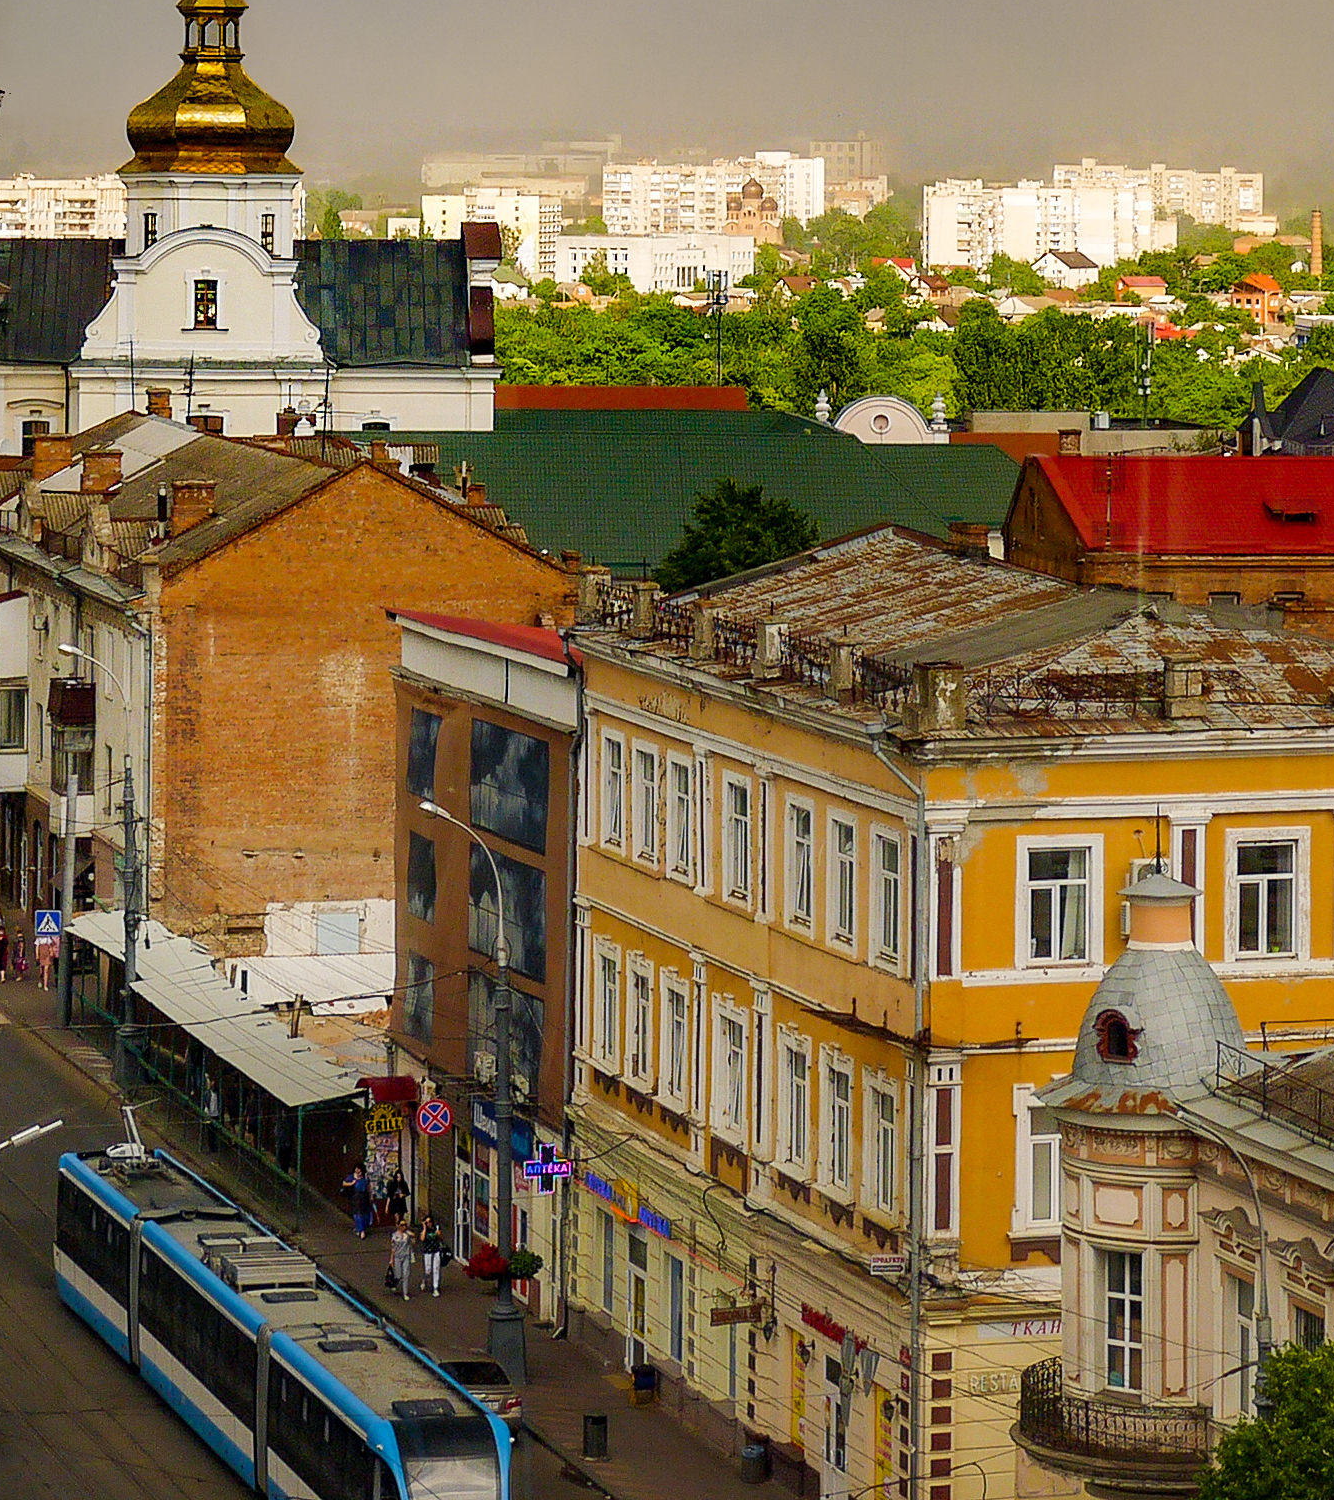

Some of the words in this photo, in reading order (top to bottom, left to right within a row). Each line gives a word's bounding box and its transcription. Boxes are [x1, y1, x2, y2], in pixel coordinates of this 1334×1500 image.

[367, 1117, 401, 1132] GRILL
[526, 1162, 568, 1174] АПТЕКА
[1011, 1320, 1062, 1336] ТКАН
[970, 1372, 1019, 1393] RESTA
